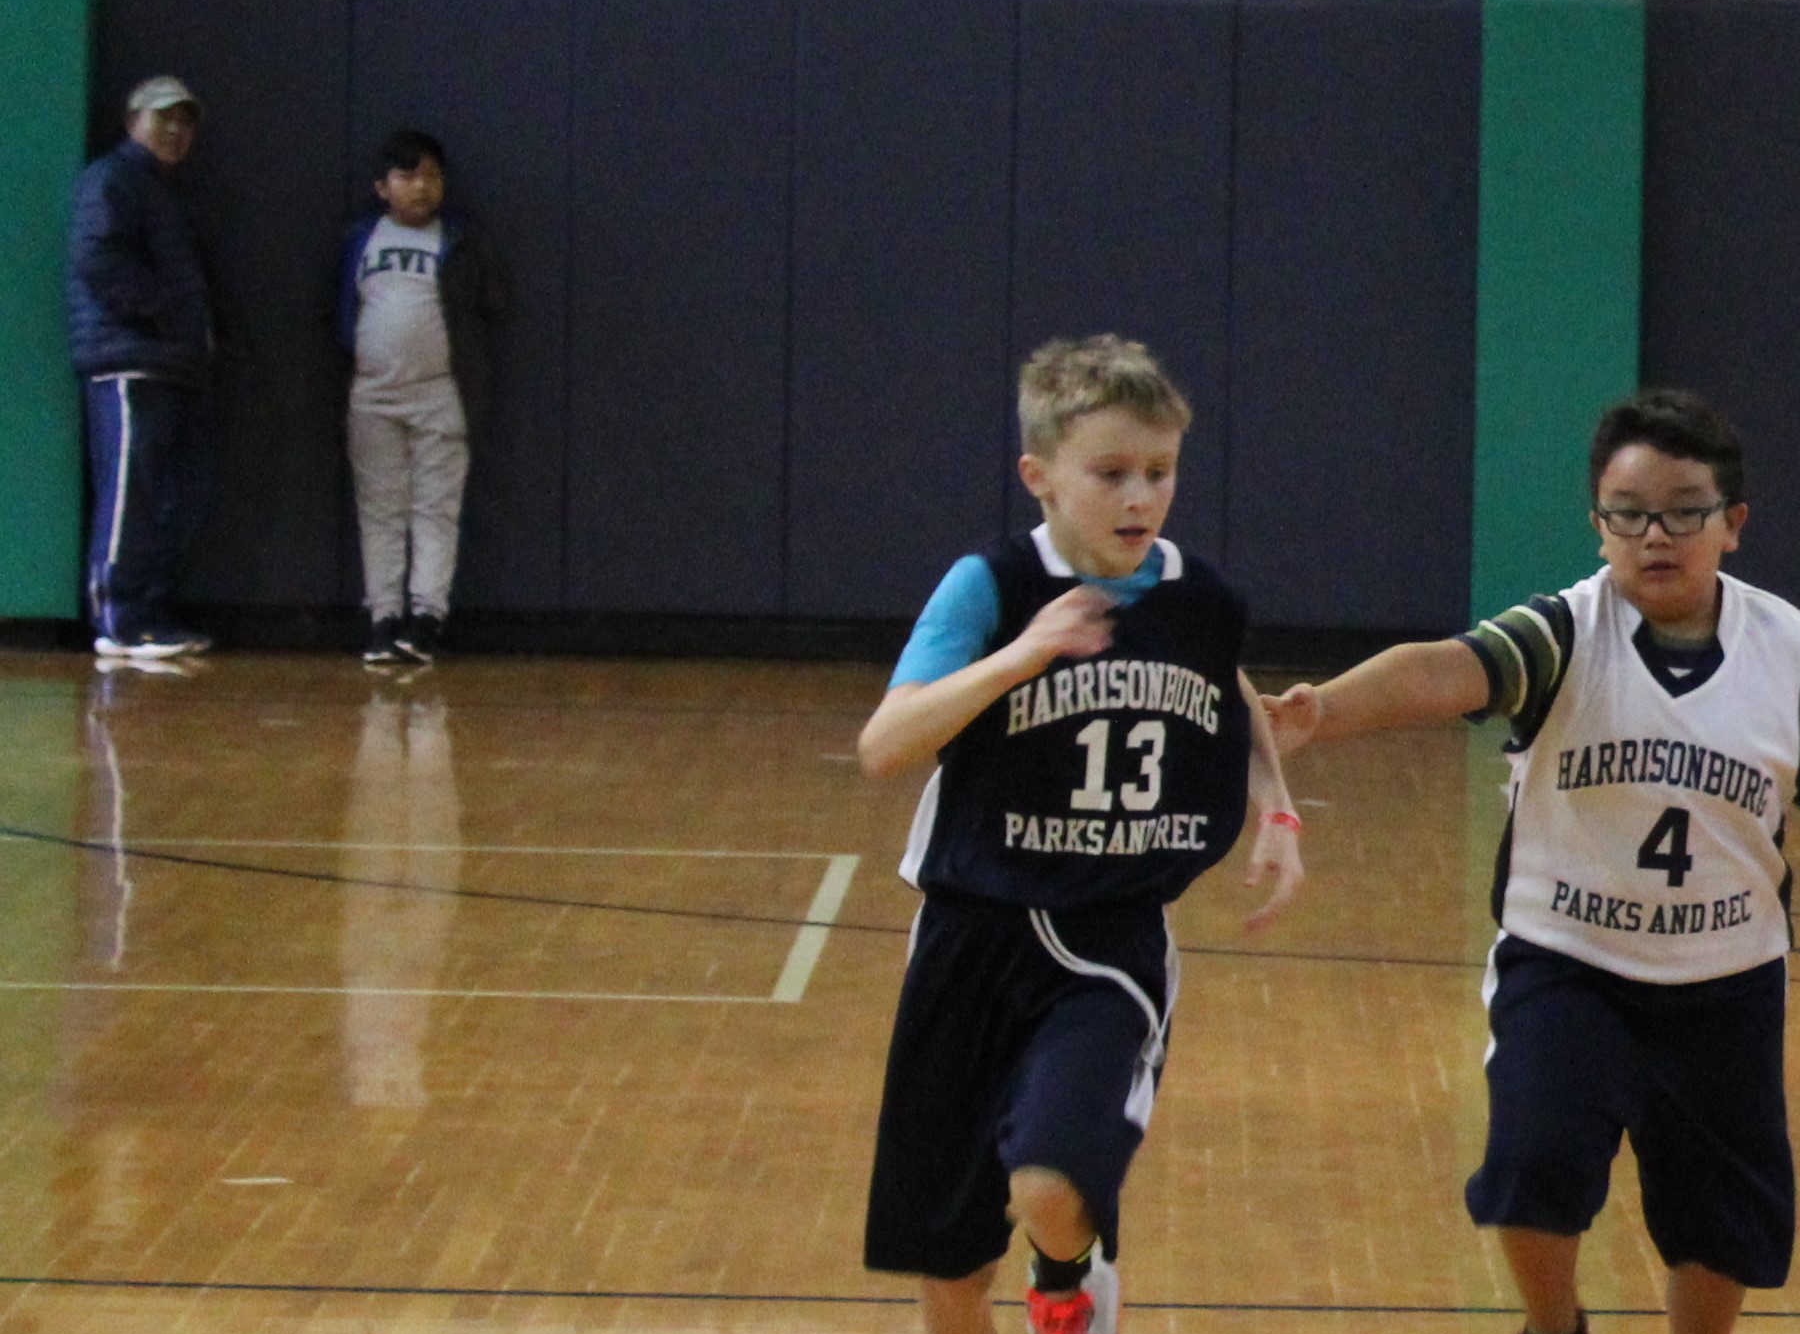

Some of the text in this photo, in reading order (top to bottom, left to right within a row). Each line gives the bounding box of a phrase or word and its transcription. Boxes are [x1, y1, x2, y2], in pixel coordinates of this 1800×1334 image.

[1006, 659, 1222, 736] HARRISONBURG
[1070, 719, 1166, 811] 13
[1556, 738, 1773, 819] HARRISONBURG
[1005, 812, 1105, 855] PARKS
[1151, 814, 1208, 851] REC
[1636, 807, 1693, 887] 4
[1550, 881, 1752, 935] PARKS AND REC
